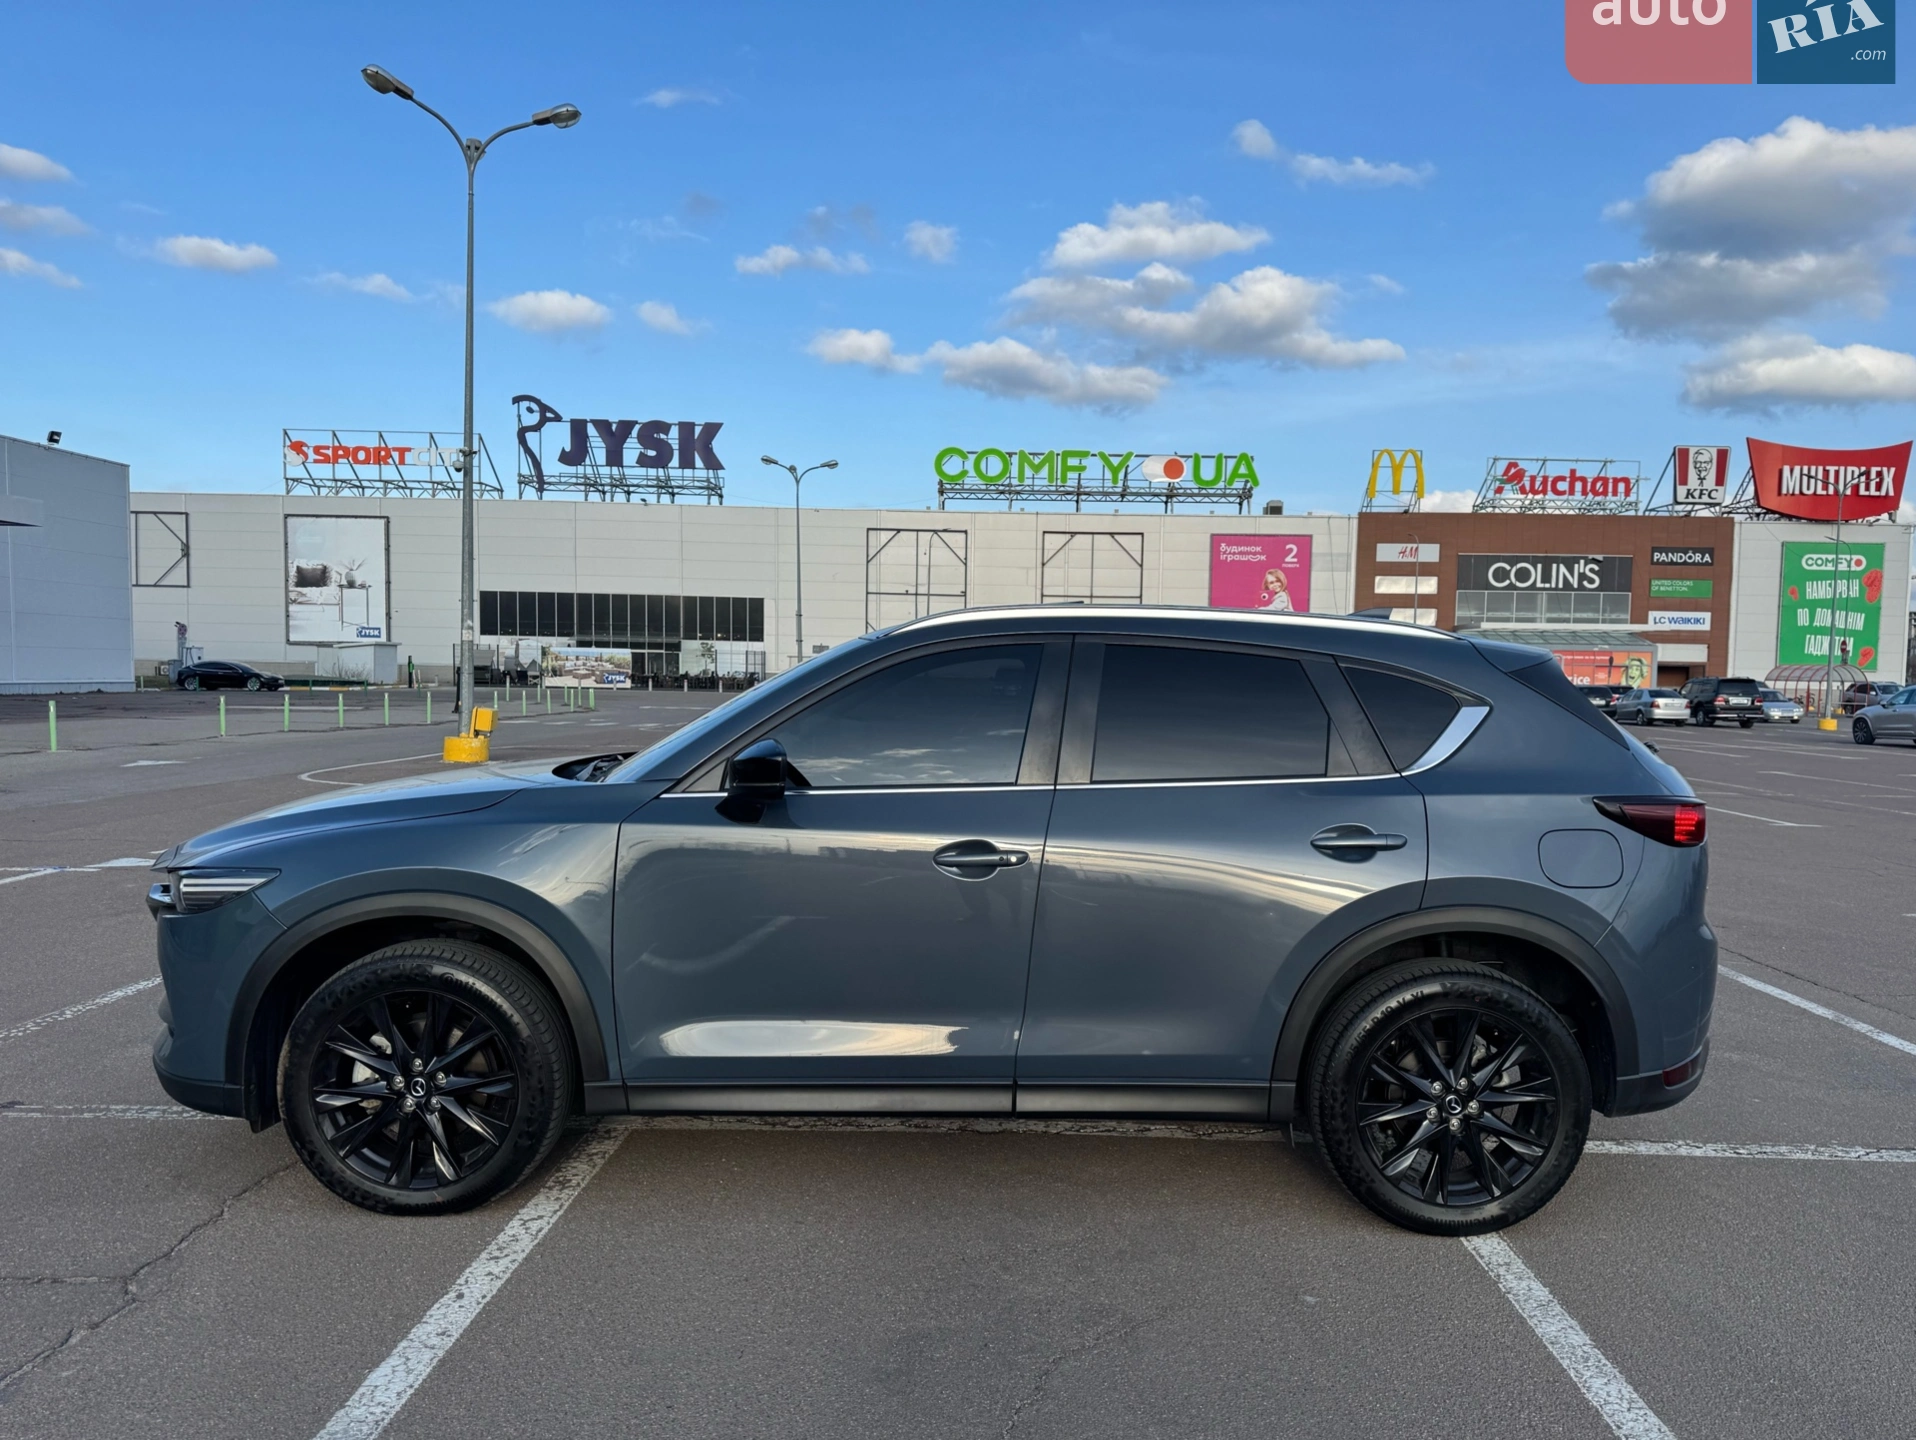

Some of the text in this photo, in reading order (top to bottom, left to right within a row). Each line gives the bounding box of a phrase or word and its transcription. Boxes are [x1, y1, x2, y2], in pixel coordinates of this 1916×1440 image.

[557, 418, 726, 470] JYSK
[312, 444, 464, 467] SPORTCIT
[934, 446, 1261, 489] COMFY UA
[1494, 461, 1631, 498] Auchan
[1780, 464, 1896, 497] MULTIPLEX
[1683, 488, 1719, 500] KFC
[1284, 543, 1298, 562] 2
[1487, 559, 1601, 589] COLIN'S
[1653, 616, 1667, 625] LC
[1797, 608, 1810, 627] ПО
[361, 628, 380, 637] JYSK
[607, 674, 626, 682] JYSK
